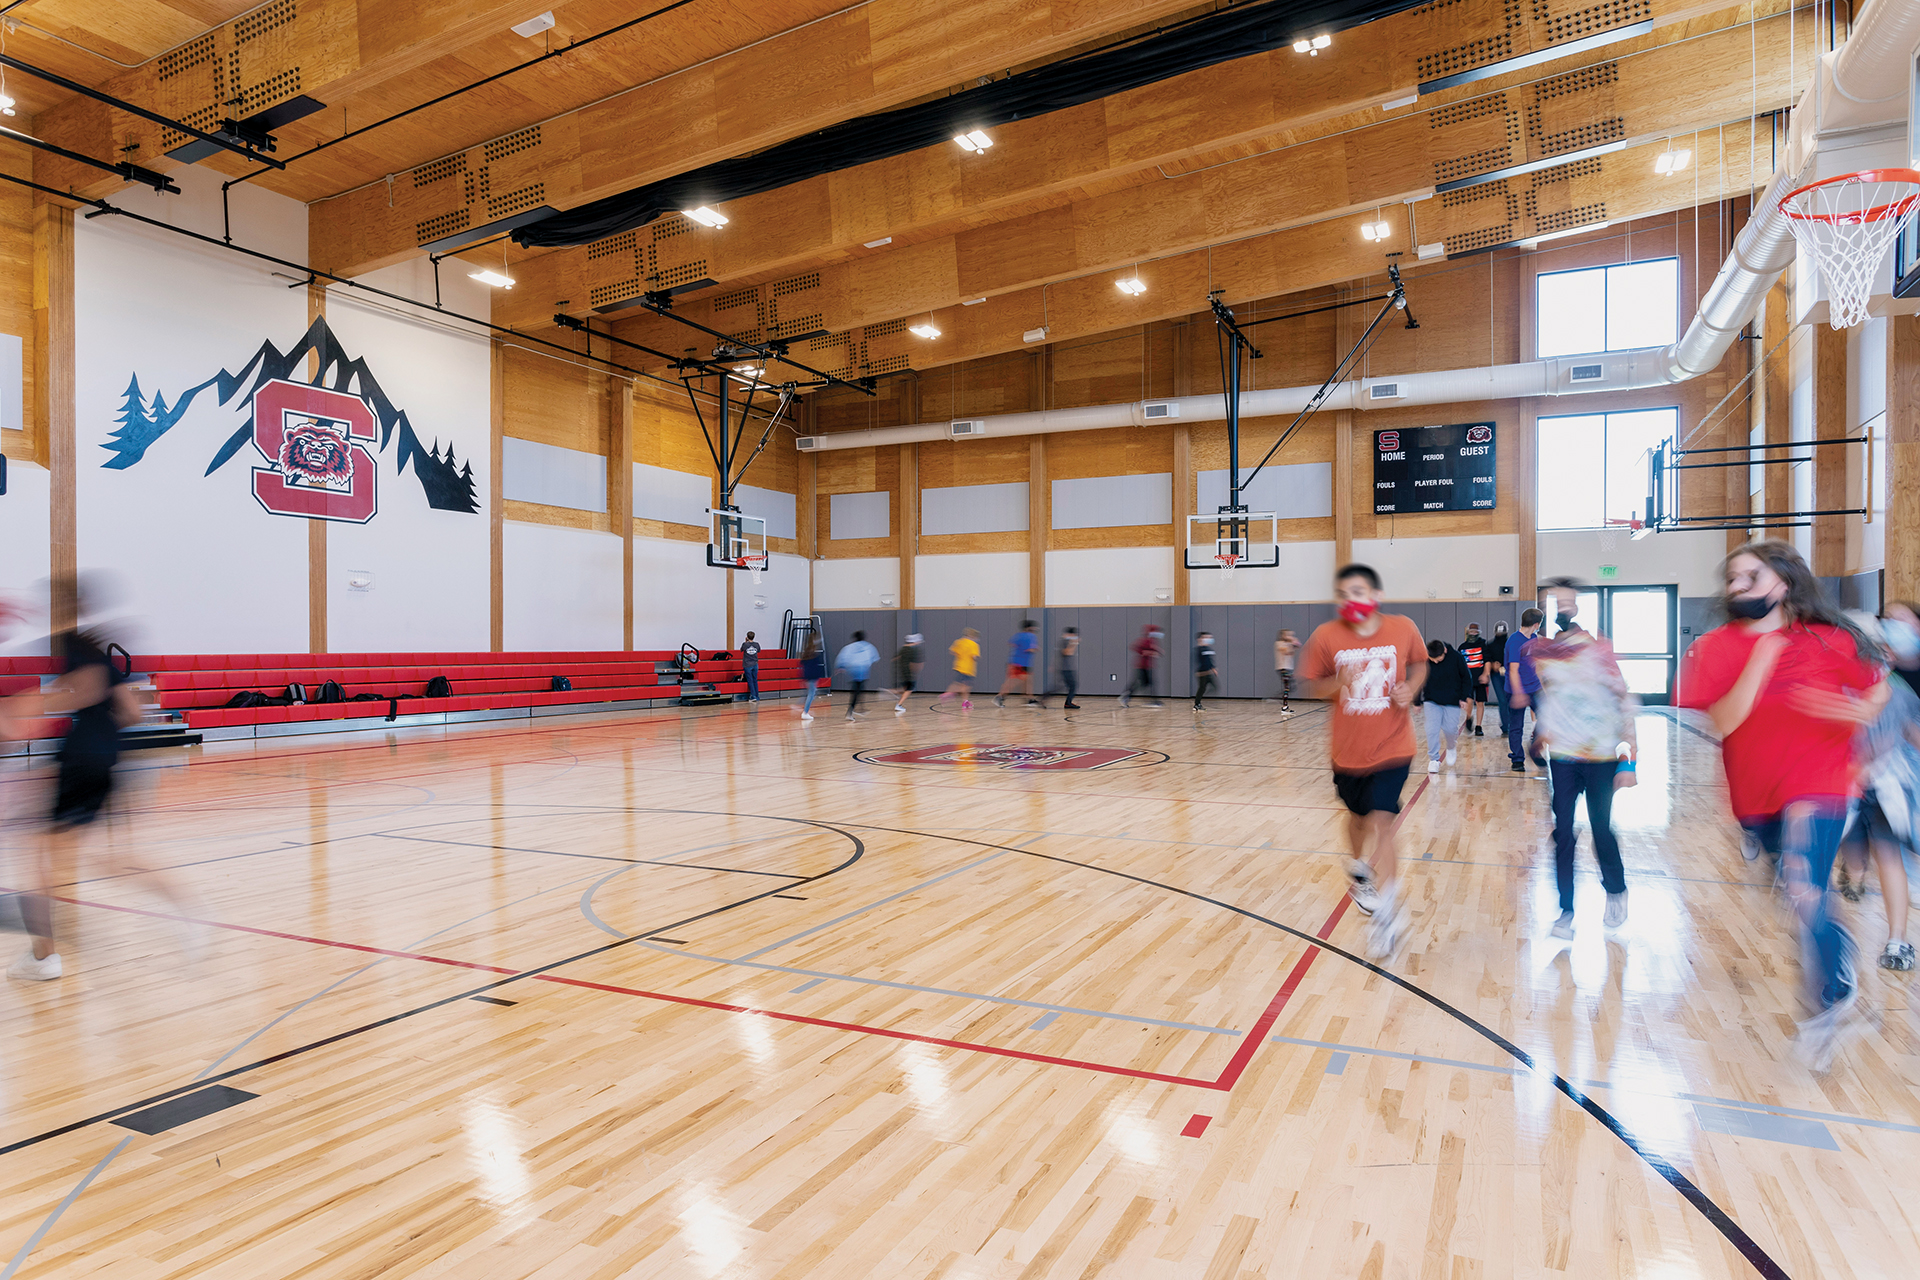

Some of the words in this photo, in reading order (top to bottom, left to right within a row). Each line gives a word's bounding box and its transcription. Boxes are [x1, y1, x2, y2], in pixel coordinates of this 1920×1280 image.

[1379, 431, 1400, 451] S
[251, 377, 378, 525] S
[1460, 446, 1490, 456] GUEST
[1381, 451, 1406, 461] HOME
[1422, 453, 1445, 461] PERIOD
[1438, 478, 1454, 486] FOUL
[1472, 476, 1493, 484] FOULS
[1376, 481, 1396, 489] FOULS
[1376, 504, 1396, 512] SCORE
